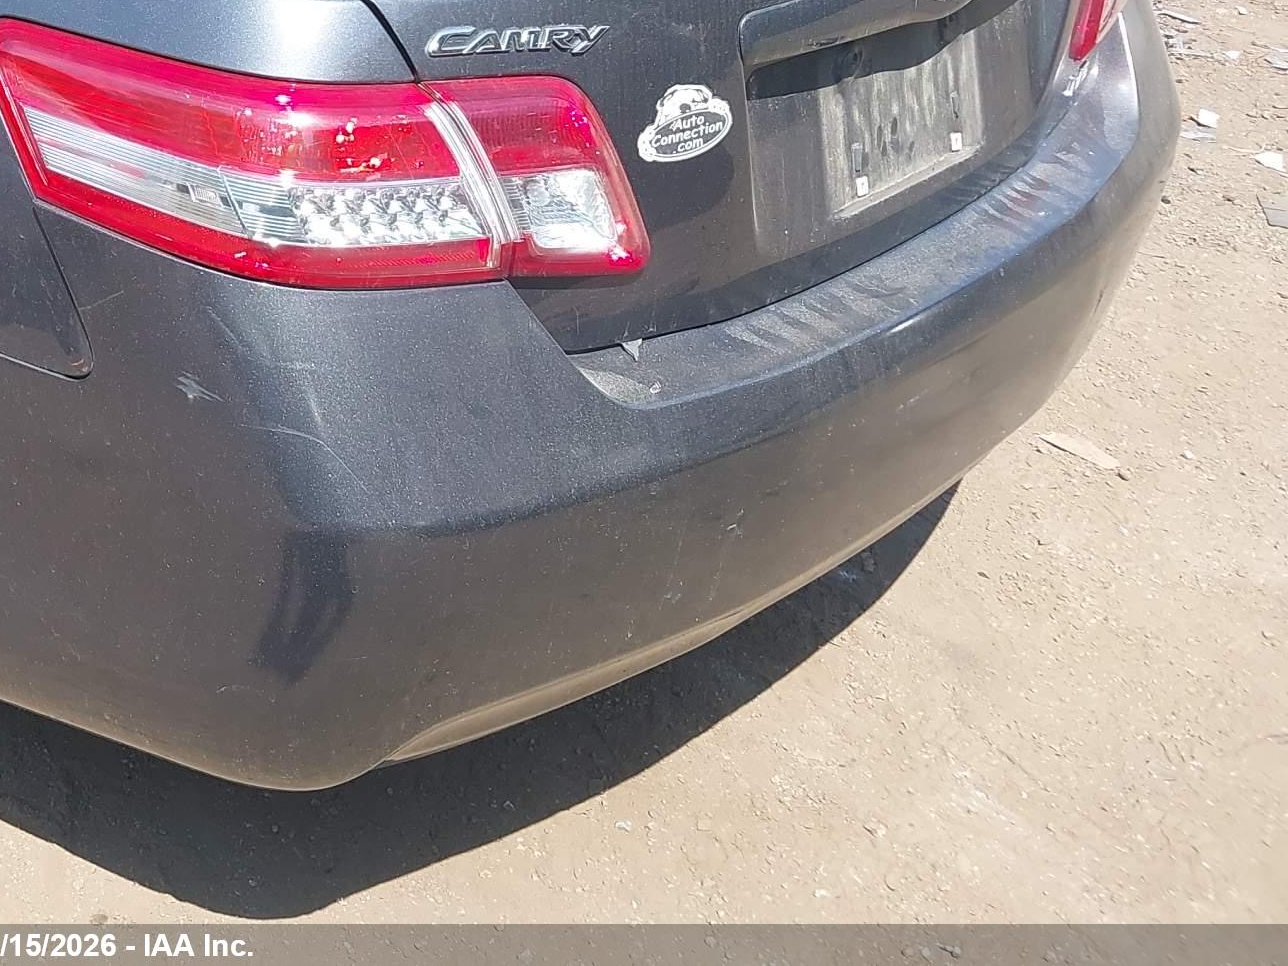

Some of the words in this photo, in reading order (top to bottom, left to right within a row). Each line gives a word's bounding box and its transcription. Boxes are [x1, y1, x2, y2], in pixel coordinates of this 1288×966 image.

[425, 24, 610, 57] CAMRY
[651, 121, 724, 148] Connection
[672, 137, 704, 154] .com
